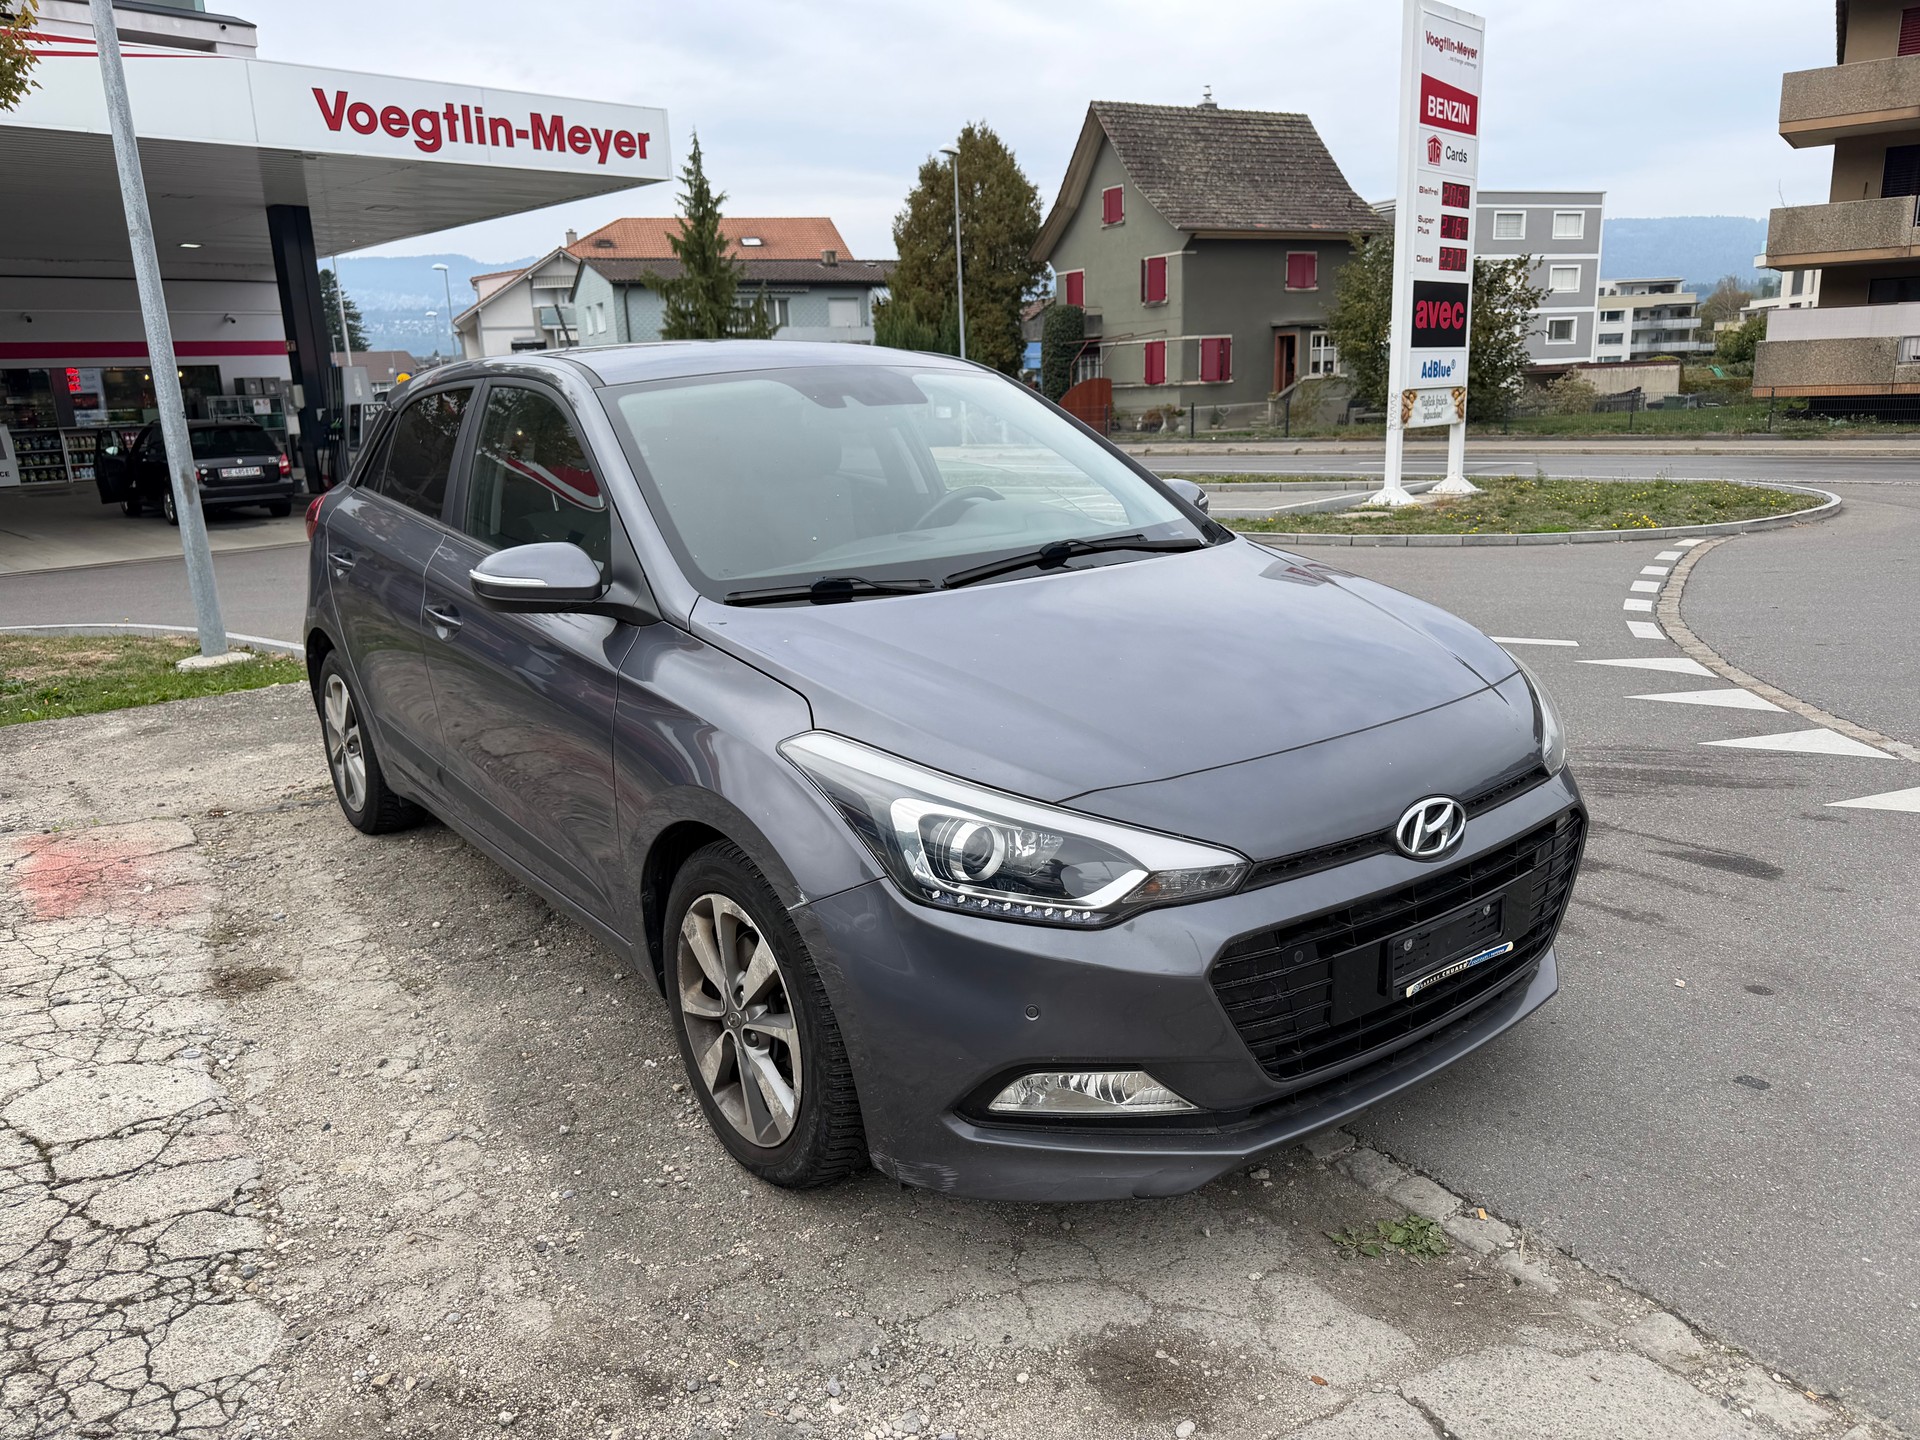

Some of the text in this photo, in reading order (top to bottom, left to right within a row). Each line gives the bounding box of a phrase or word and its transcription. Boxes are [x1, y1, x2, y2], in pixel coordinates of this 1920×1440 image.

[1425, 30, 1478, 60] Voegtlin-Meyer
[1427, 95, 1470, 126] BENZIN
[311, 87, 650, 165] Voegtlin-Meyer
[1445, 145, 1468, 164] Cards
[1418, 185, 1439, 196] Bleifrei
[1417, 214, 1435, 226] Super
[1417, 226, 1430, 235] Plus
[1416, 254, 1434, 263] Diesel
[1415, 299, 1465, 330] avec
